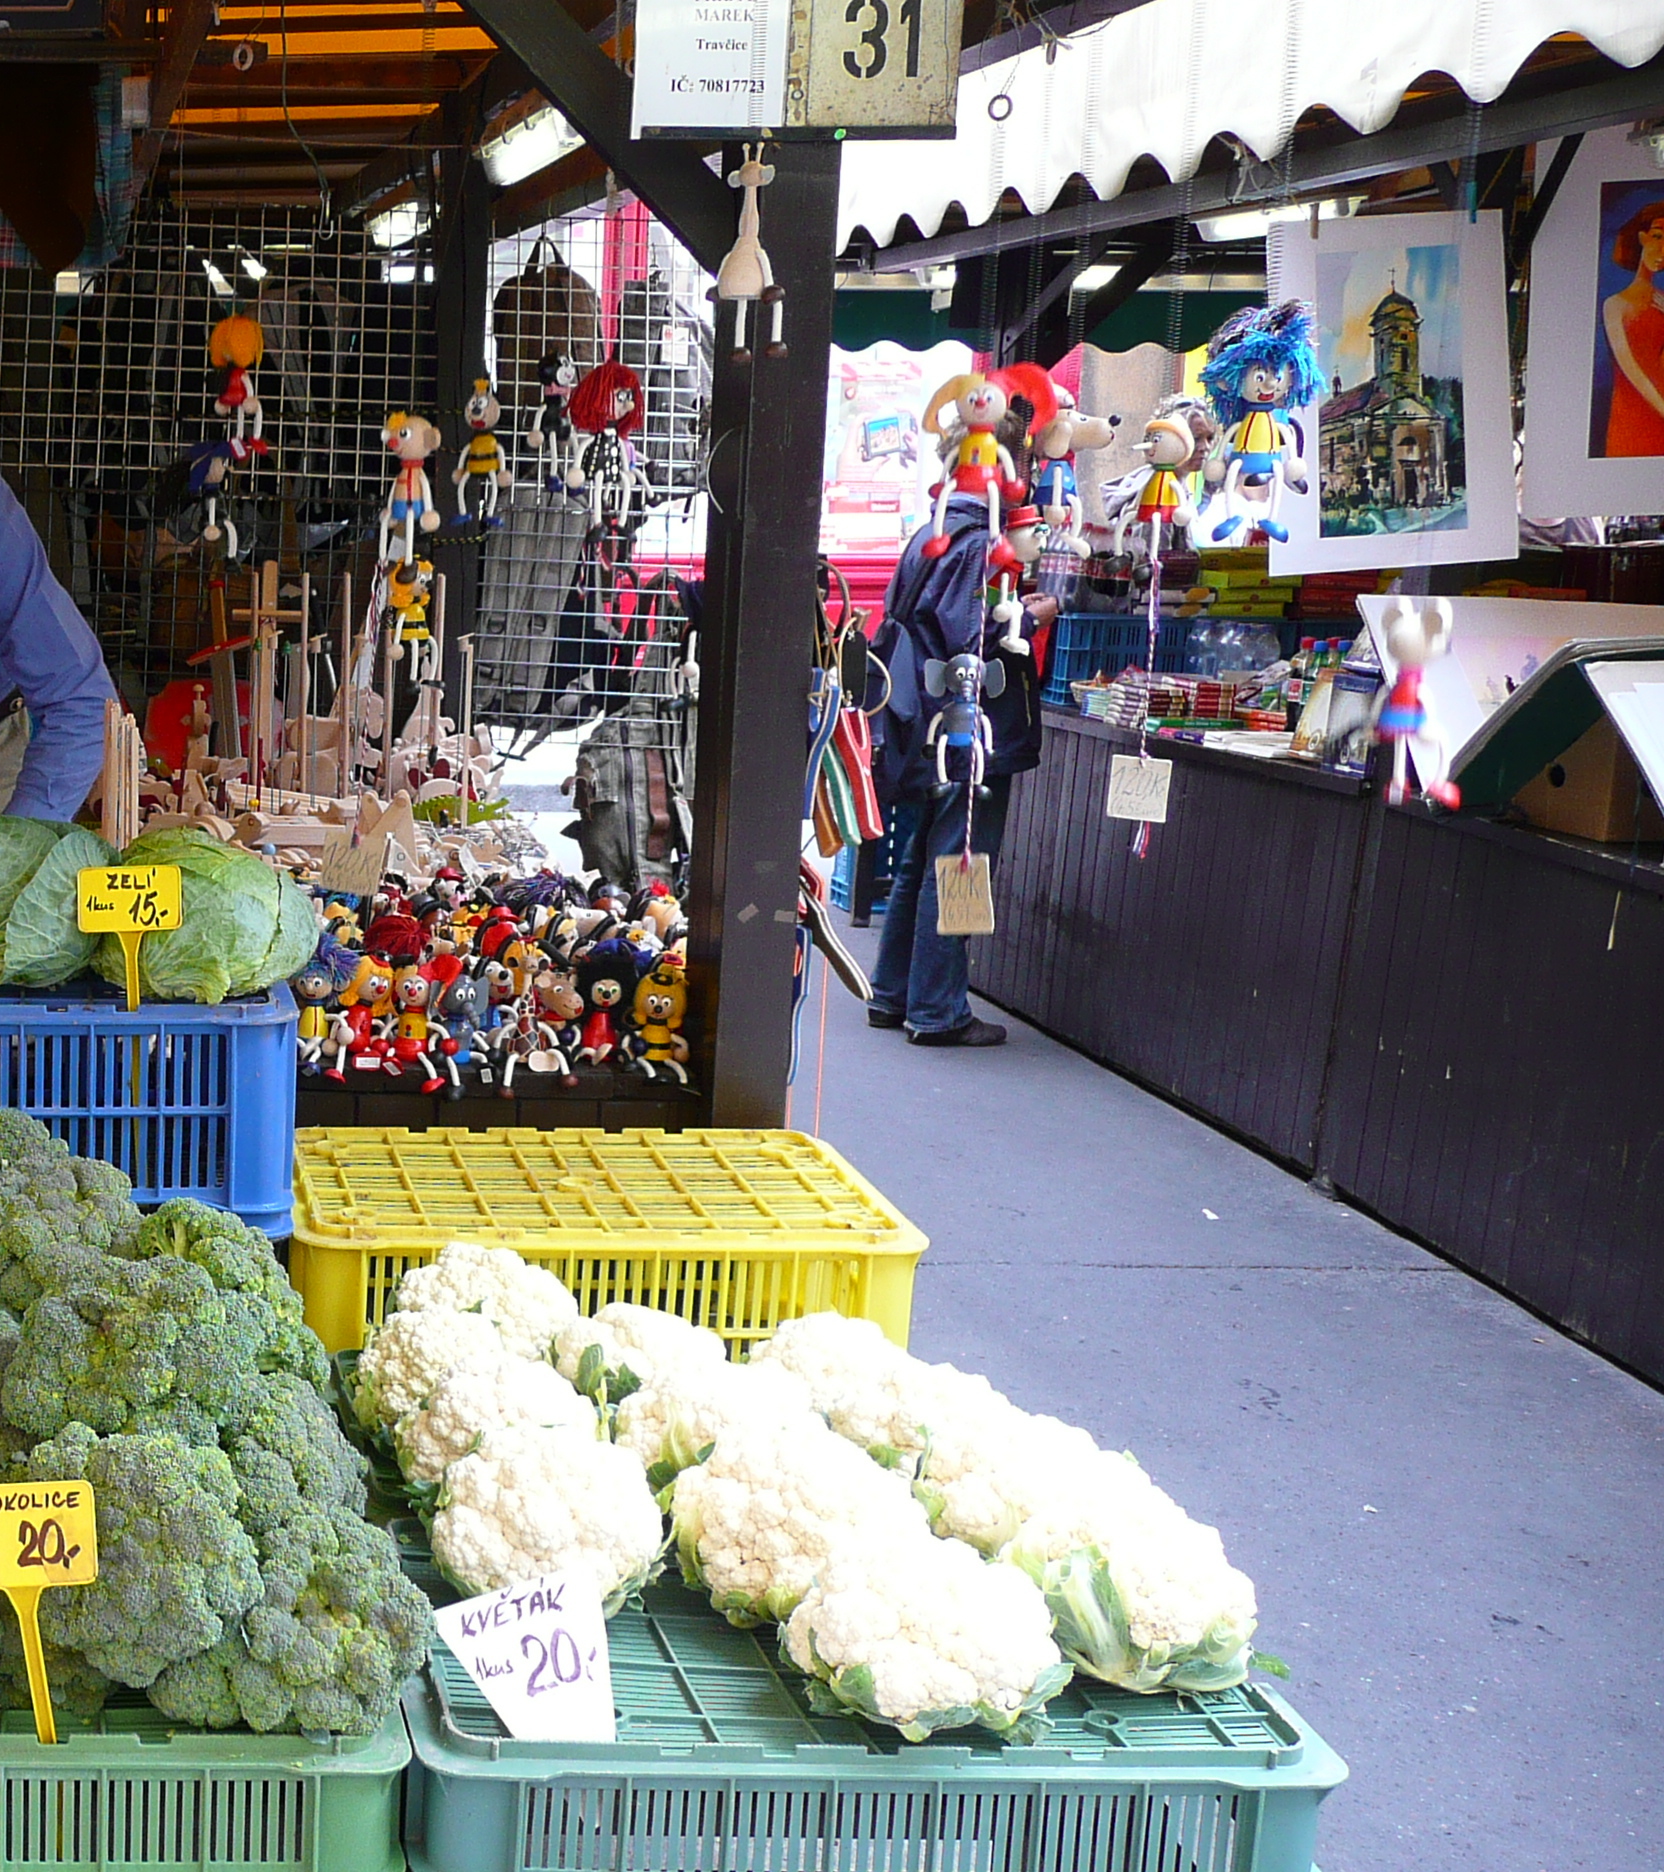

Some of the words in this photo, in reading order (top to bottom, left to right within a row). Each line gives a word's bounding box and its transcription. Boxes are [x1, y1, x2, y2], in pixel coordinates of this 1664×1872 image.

[695, 8, 755, 22] MAREK
[695, 38, 748, 51] Travčice
[843, 0, 921, 79] 31
[698, 79, 765, 93] 70817723
[106, 867, 156, 891] ZELÍ
[86, 895, 115, 912] 1kus
[128, 890, 168, 927] 15,-
[17, 1518, 81, 1569] 20,-
[460, 1577, 566, 1638] KVĚTÁK
[475, 1656, 514, 1681] 1kus
[520, 1628, 597, 1697] 20,-
